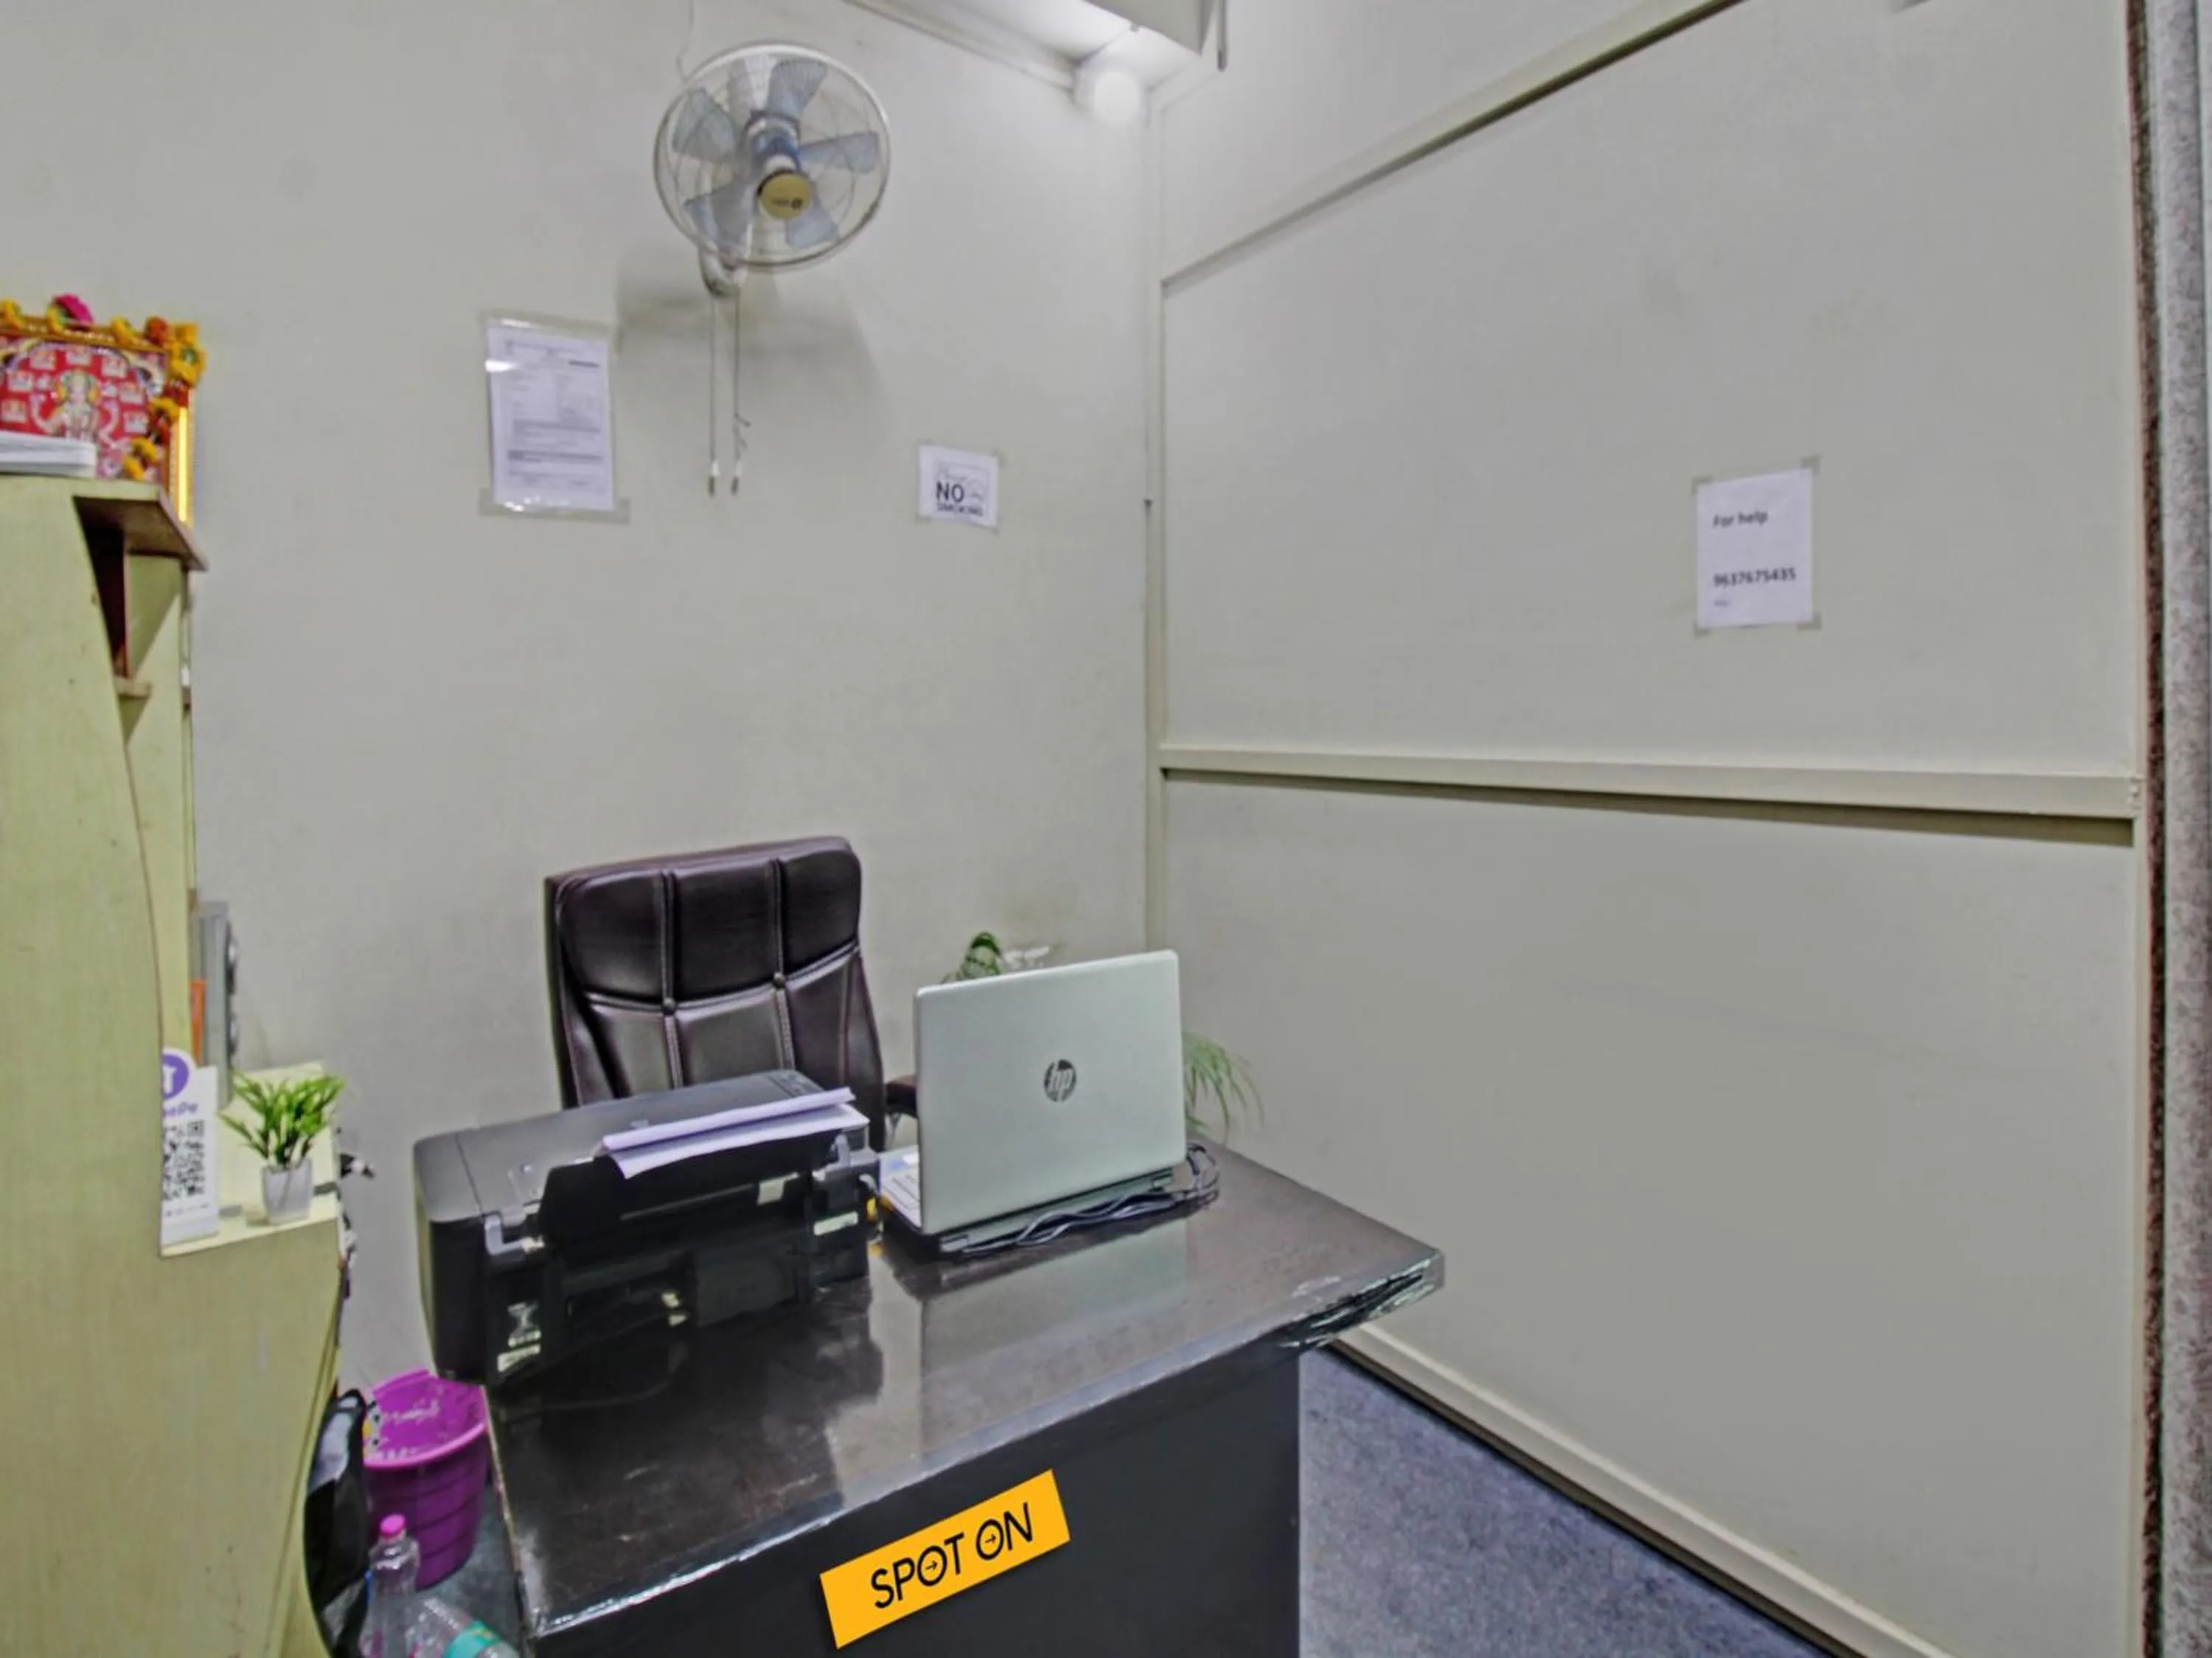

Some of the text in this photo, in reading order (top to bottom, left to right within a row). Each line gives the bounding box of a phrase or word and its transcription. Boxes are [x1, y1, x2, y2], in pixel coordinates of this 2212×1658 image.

[936, 482, 964, 503] NO
[1713, 510, 1768, 528] For help
[1044, 1059, 1077, 1102] hp
[870, 1502, 1033, 1609] SPOT ON
